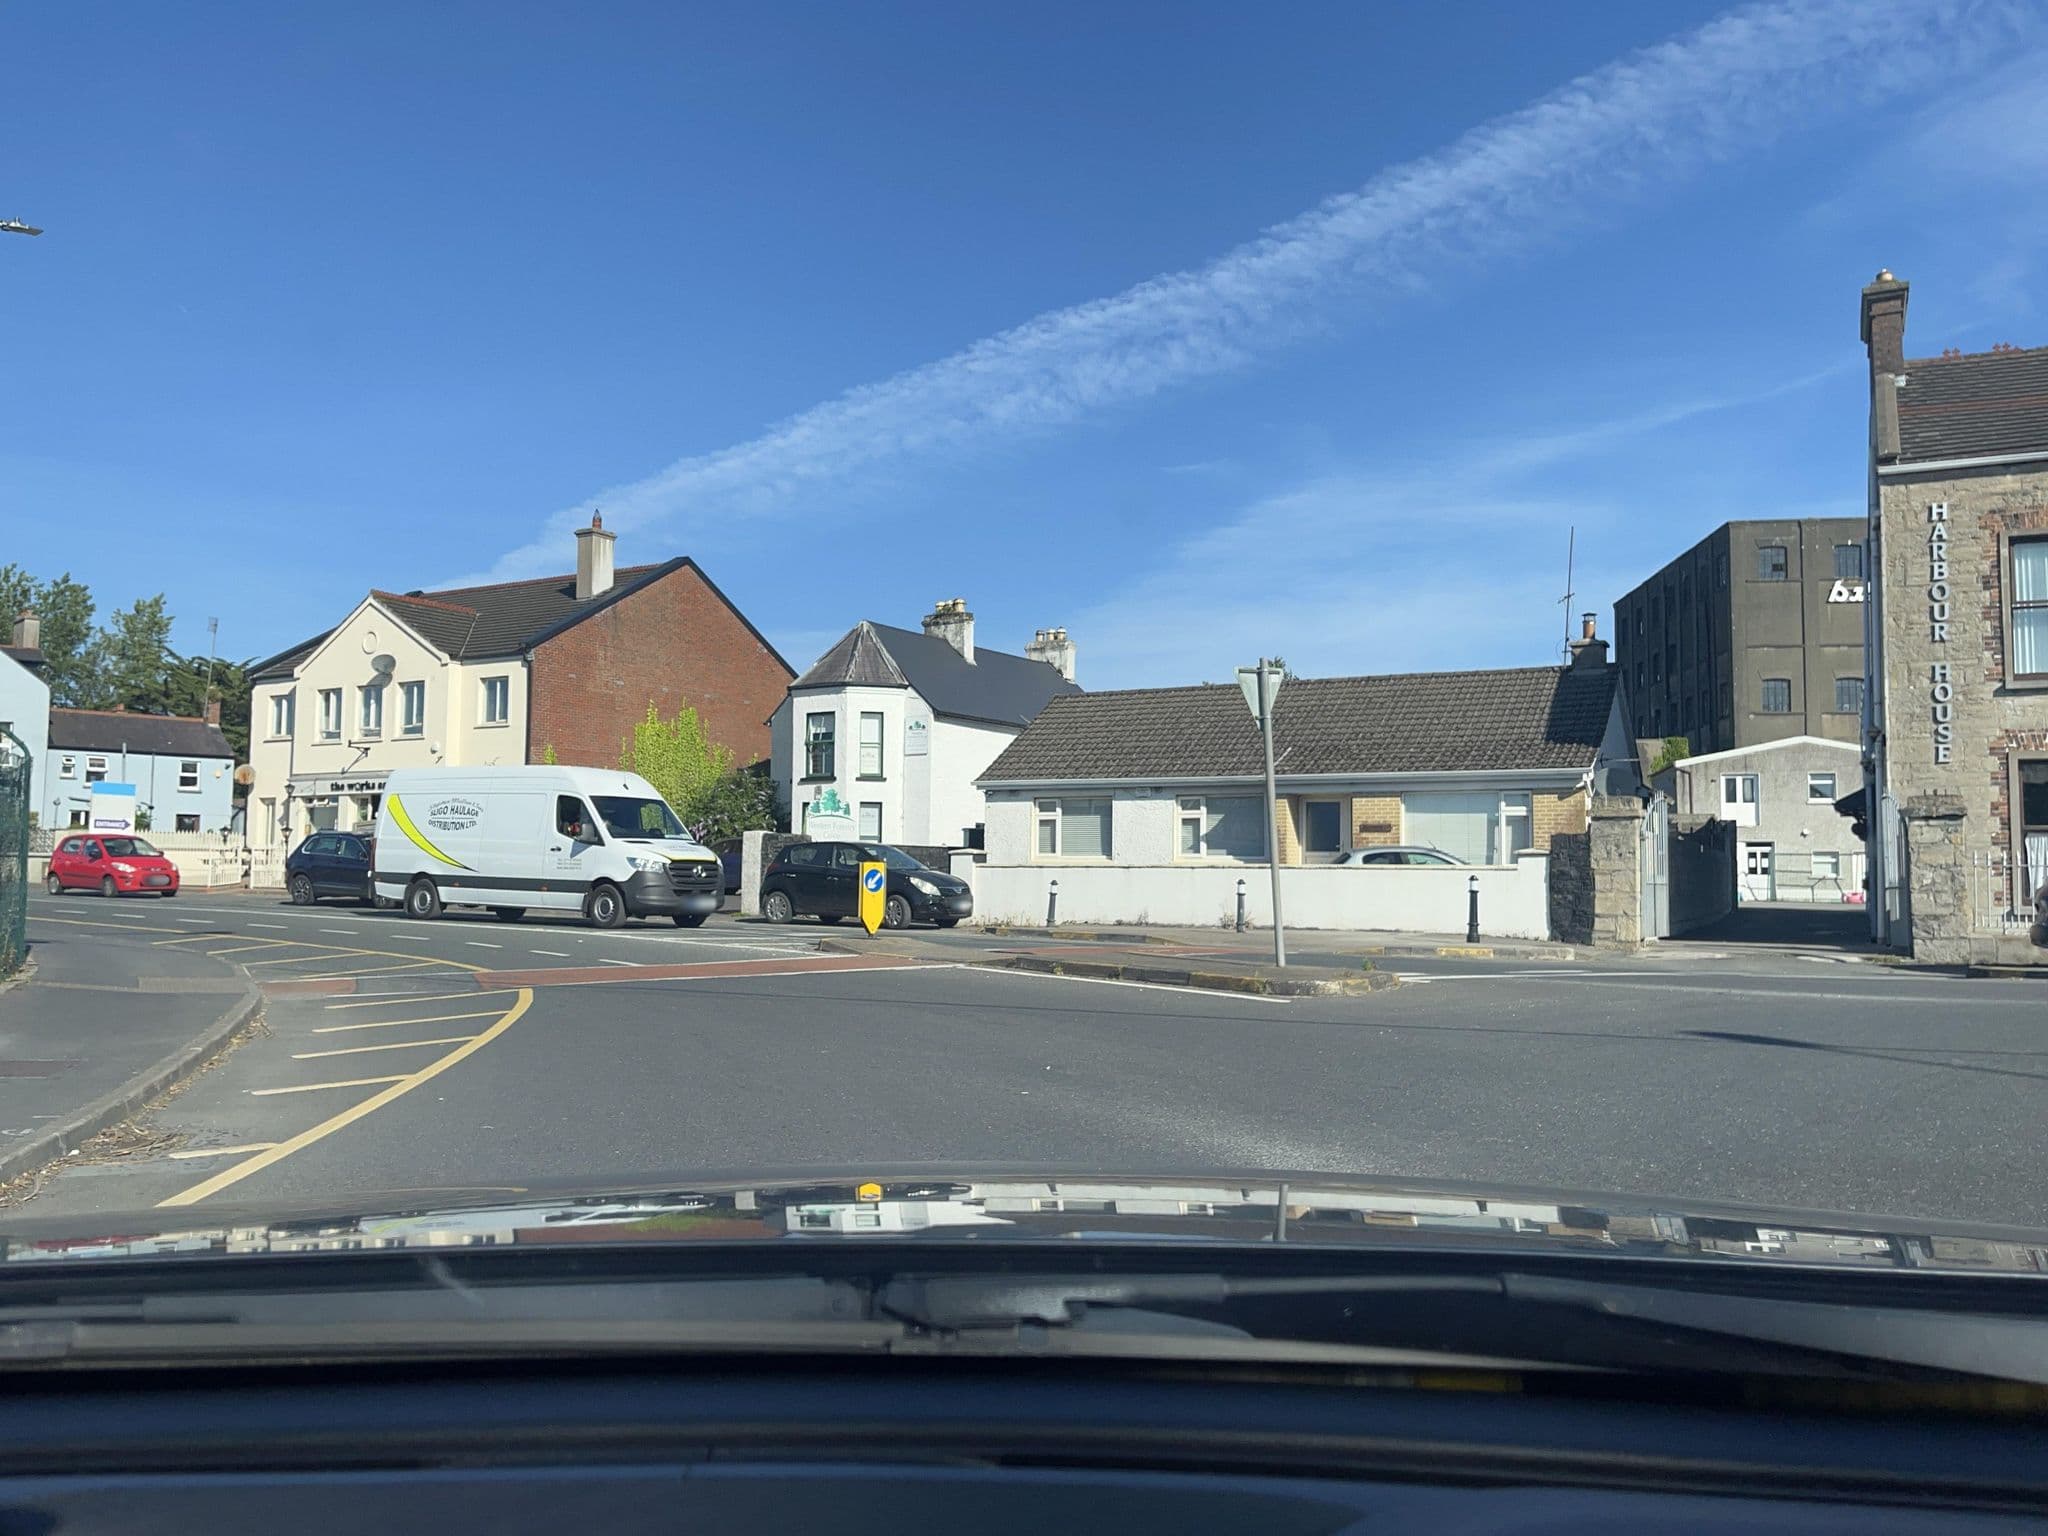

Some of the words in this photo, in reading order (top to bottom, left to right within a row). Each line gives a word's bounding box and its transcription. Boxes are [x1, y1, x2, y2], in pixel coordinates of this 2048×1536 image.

[1928, 502, 1950, 642] HARBOUR
[1931, 663, 1953, 765] HOUSE
[330, 781, 345, 792] the
[347, 780, 376, 792] works
[430, 805, 449, 817] SLIGO
[450, 804, 479, 817] HAULAGE
[428, 819, 465, 831] DISTRIBUTION
